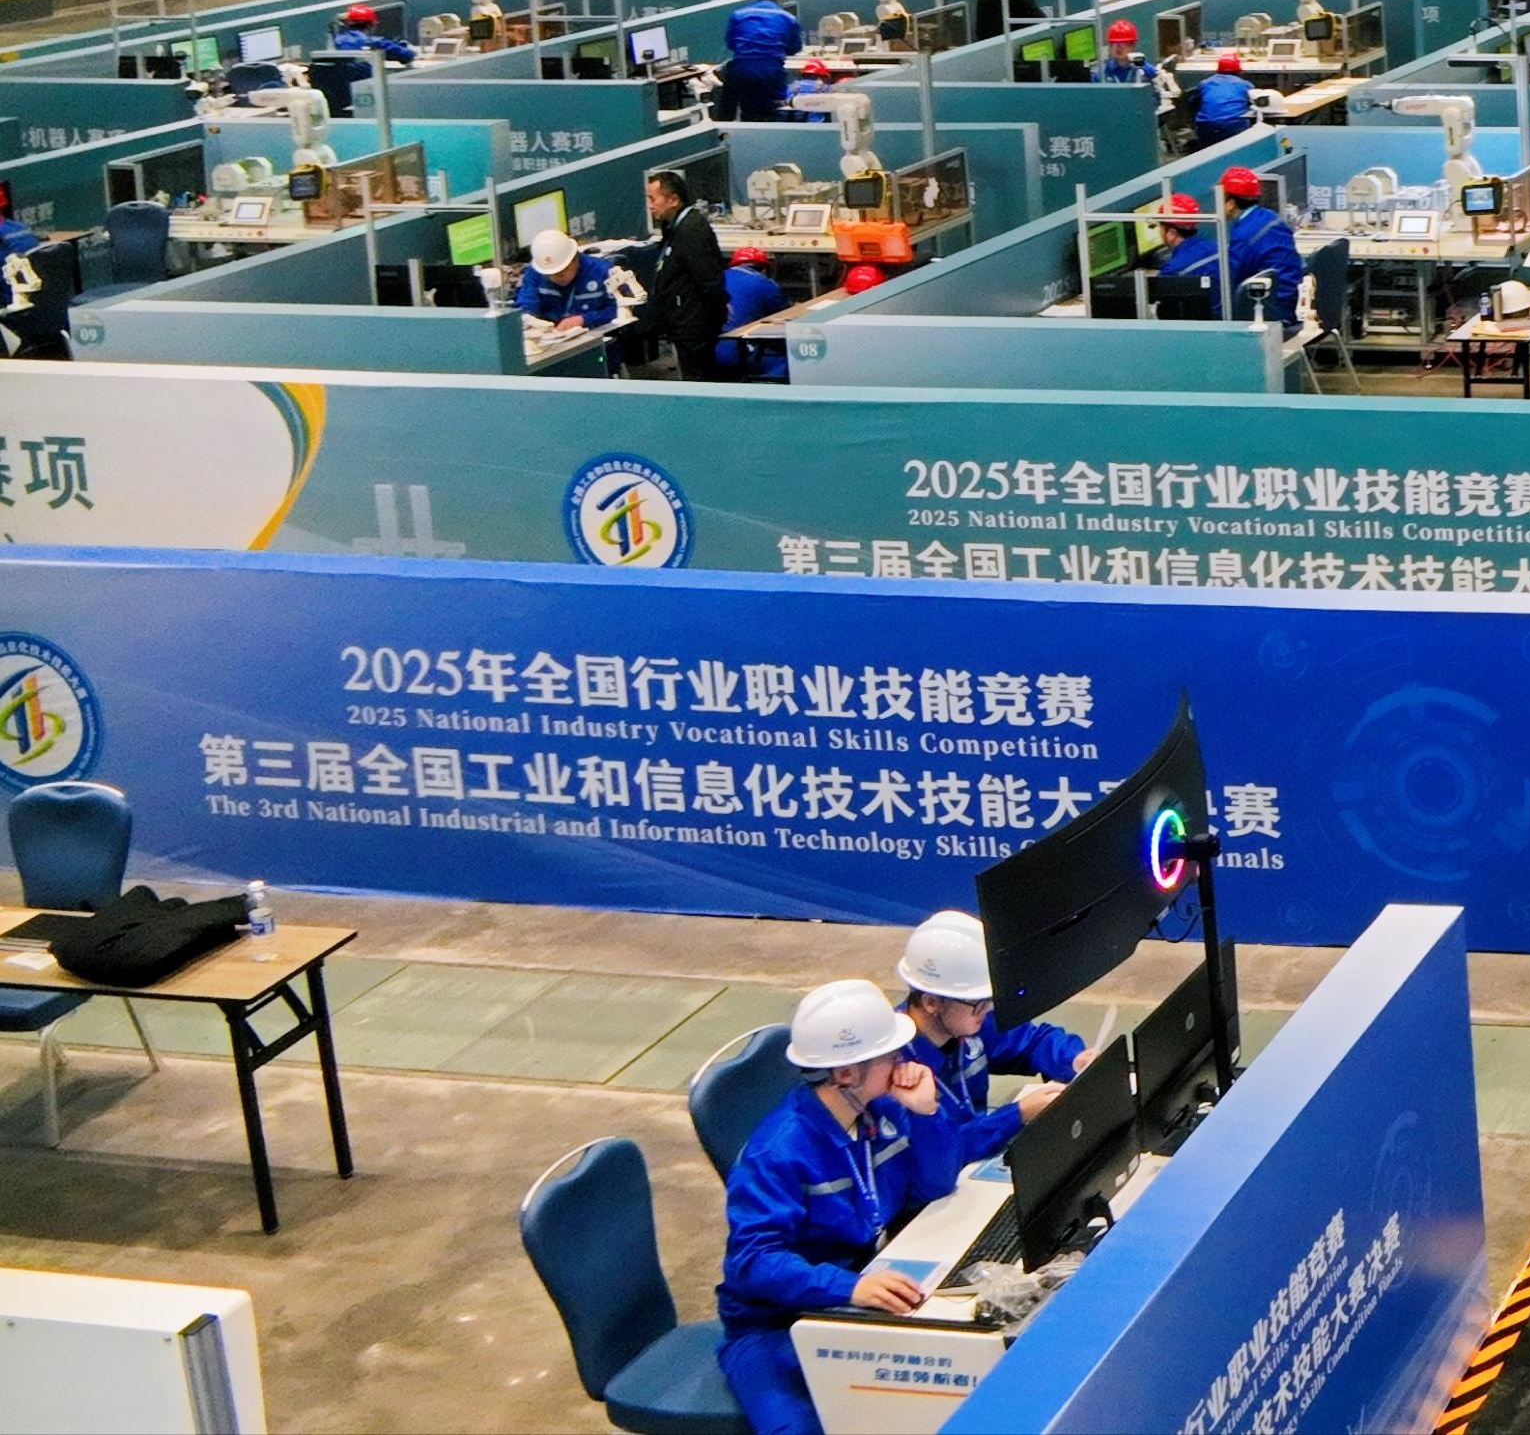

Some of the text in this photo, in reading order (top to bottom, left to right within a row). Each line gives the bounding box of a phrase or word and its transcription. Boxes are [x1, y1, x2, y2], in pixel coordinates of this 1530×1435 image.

[799, 342, 819, 357] 08
[907, 507, 960, 528] 2025
[967, 509, 1068, 532] National
[1076, 512, 1179, 539] Industry
[1187, 515, 1318, 538] Vocational
[1324, 519, 1394, 542] Skills
[340, 646, 1095, 729] 2025年全国行业职业技能竞赛
[346, 704, 1099, 763] 2025 National Industry Vocational Skills Competition
[199, 732, 1282, 839] 第三届全国工业和信息化技术技能大赛
[206, 794, 1285, 870] The 3rd National Industrial and Information Technology Skills inals
[1260, 1337, 1290, 1384] Skills
[1291, 1255, 1349, 1341] Competition
[1327, 1294, 1378, 1374] Competition
[1378, 1256, 1403, 1300] Finals
[815, 1347, 952, 1368] 智能科技产教融合的
[873, 1367, 979, 1388] 全球领航者！
